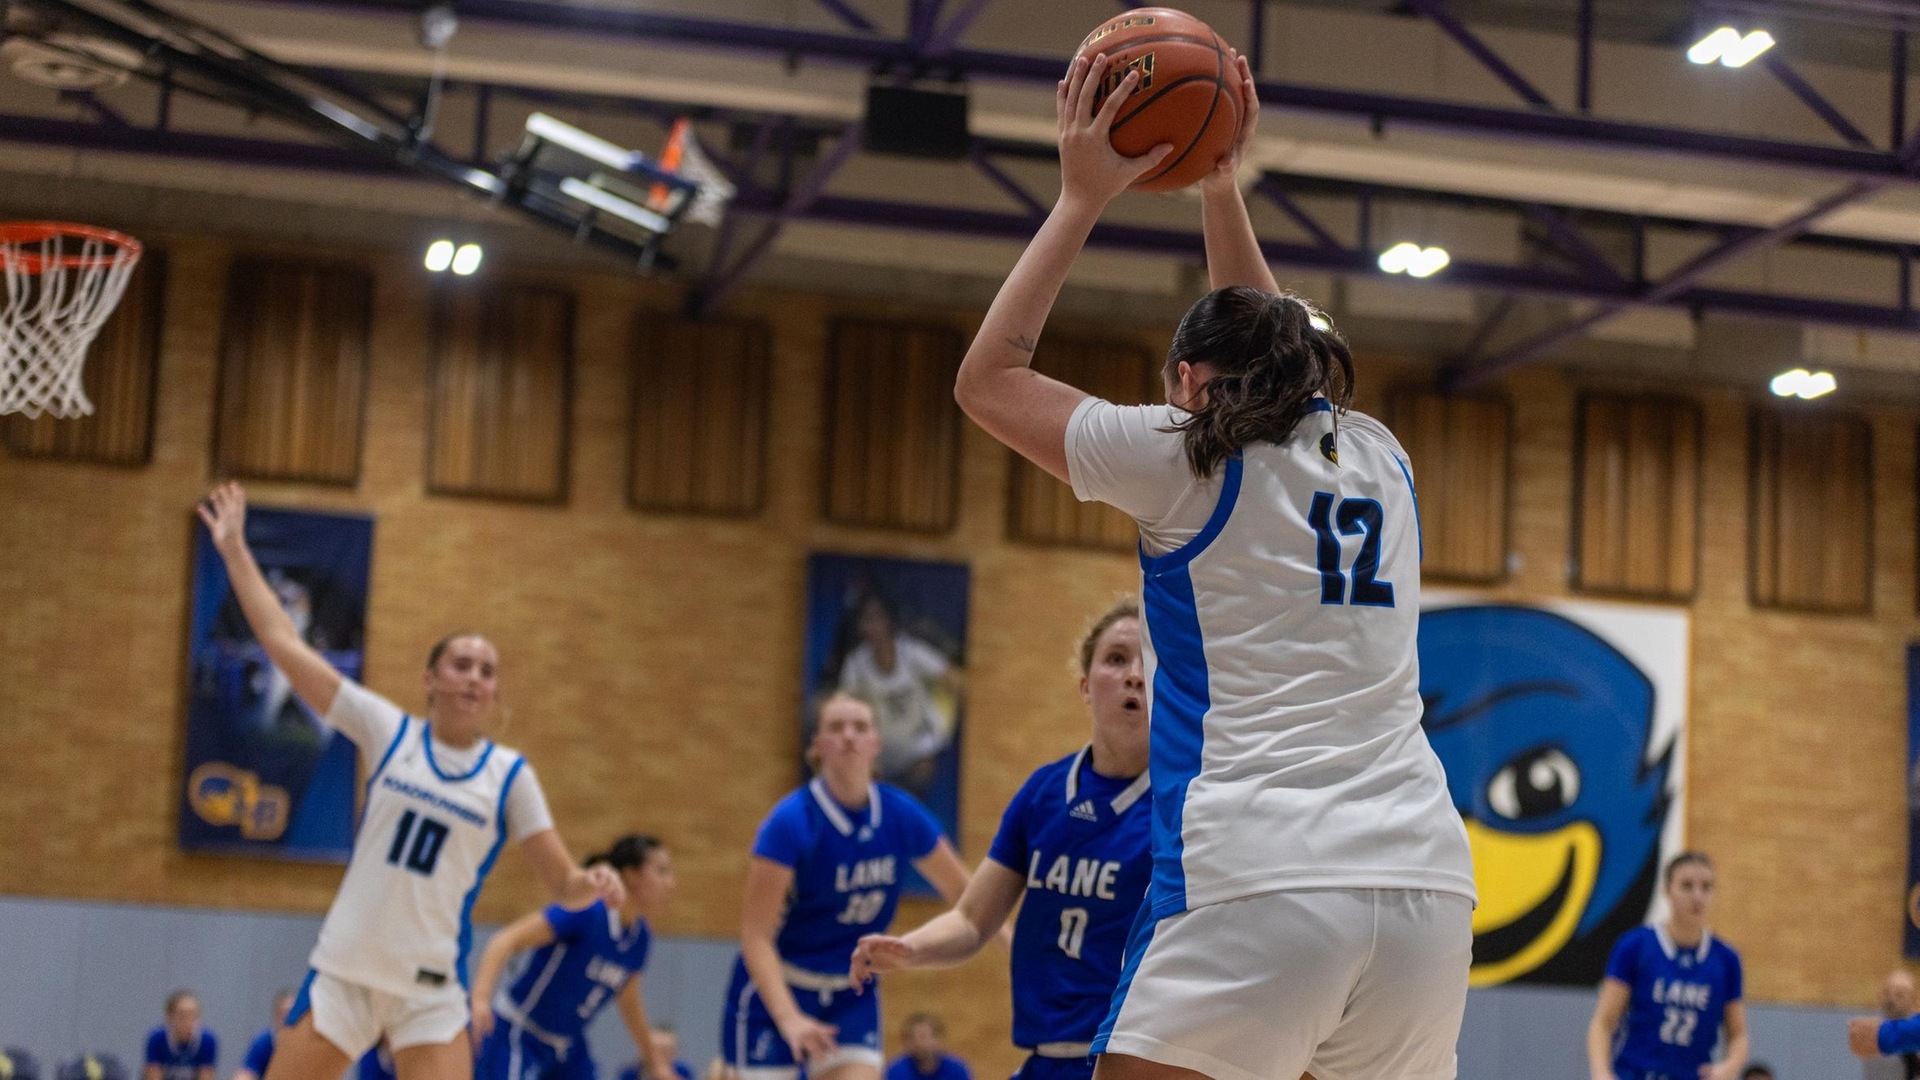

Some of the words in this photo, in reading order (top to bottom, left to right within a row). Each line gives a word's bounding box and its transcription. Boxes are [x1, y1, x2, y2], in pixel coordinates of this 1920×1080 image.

[1307, 490, 1396, 608] 12
[386, 808, 451, 876] 10
[835, 855, 897, 893] LANE
[1027, 850, 1122, 900] LANE
[1057, 907, 1089, 960] 0
[1652, 977, 1711, 1012] LANE
[1659, 1006, 1699, 1047] 22
